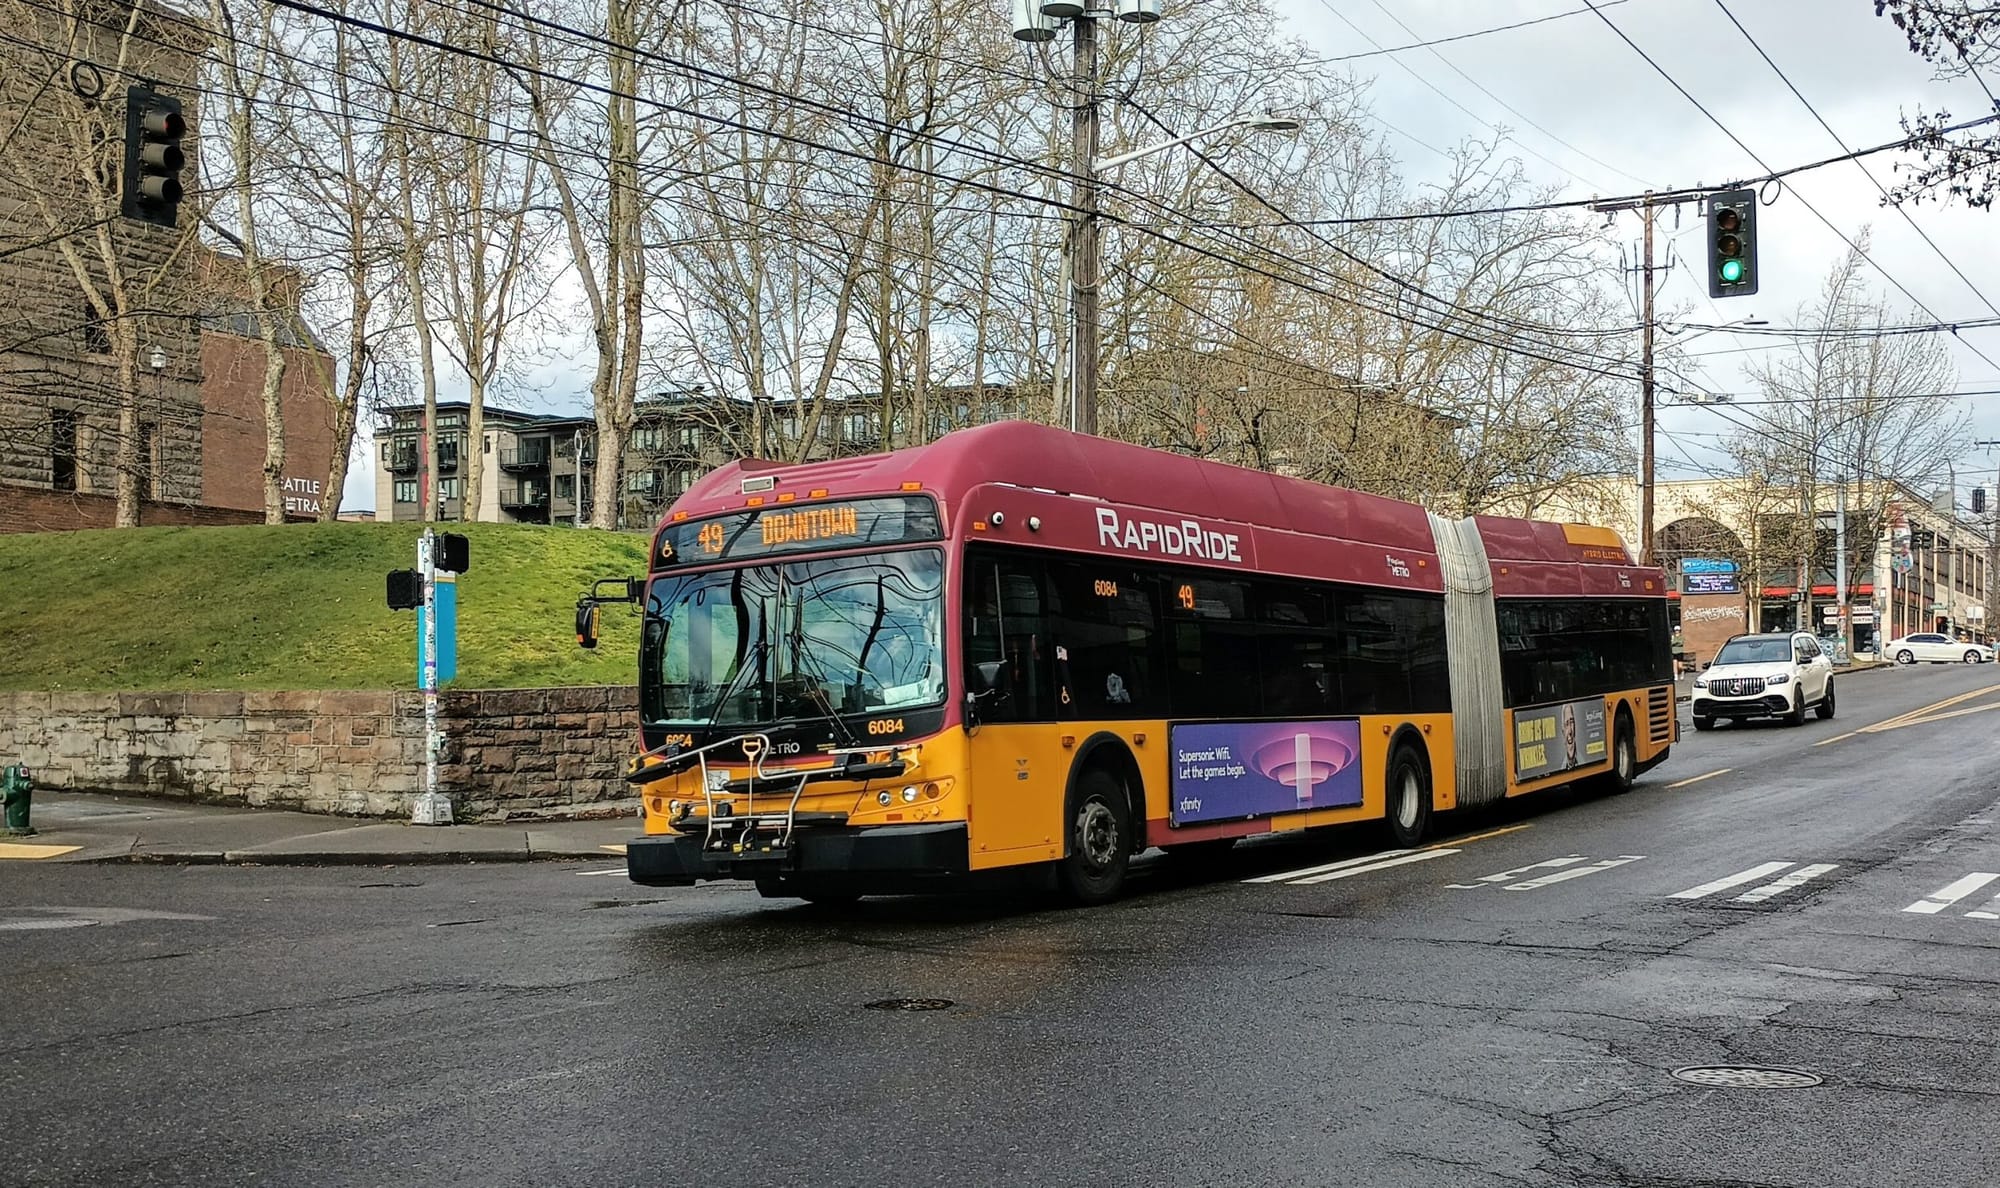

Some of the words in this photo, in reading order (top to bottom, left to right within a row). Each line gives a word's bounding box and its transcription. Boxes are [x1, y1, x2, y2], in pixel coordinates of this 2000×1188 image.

[280, 477, 320, 494] ATTLE
[698, 523, 724, 554] 49
[762, 507, 857, 545] DOWNTOWN
[1094, 579, 1118, 597] 6084
[1178, 584, 1194, 609] 49
[868, 718, 904, 735] 6084
[1179, 747, 1215, 765] Supersonic
[1179, 766, 1191, 779] Let
[1191, 765, 1203, 778] the
[1204, 766, 1226, 781] games
[1226, 762, 1246, 779] begin.
[1180, 797, 1201, 814] xfinity
